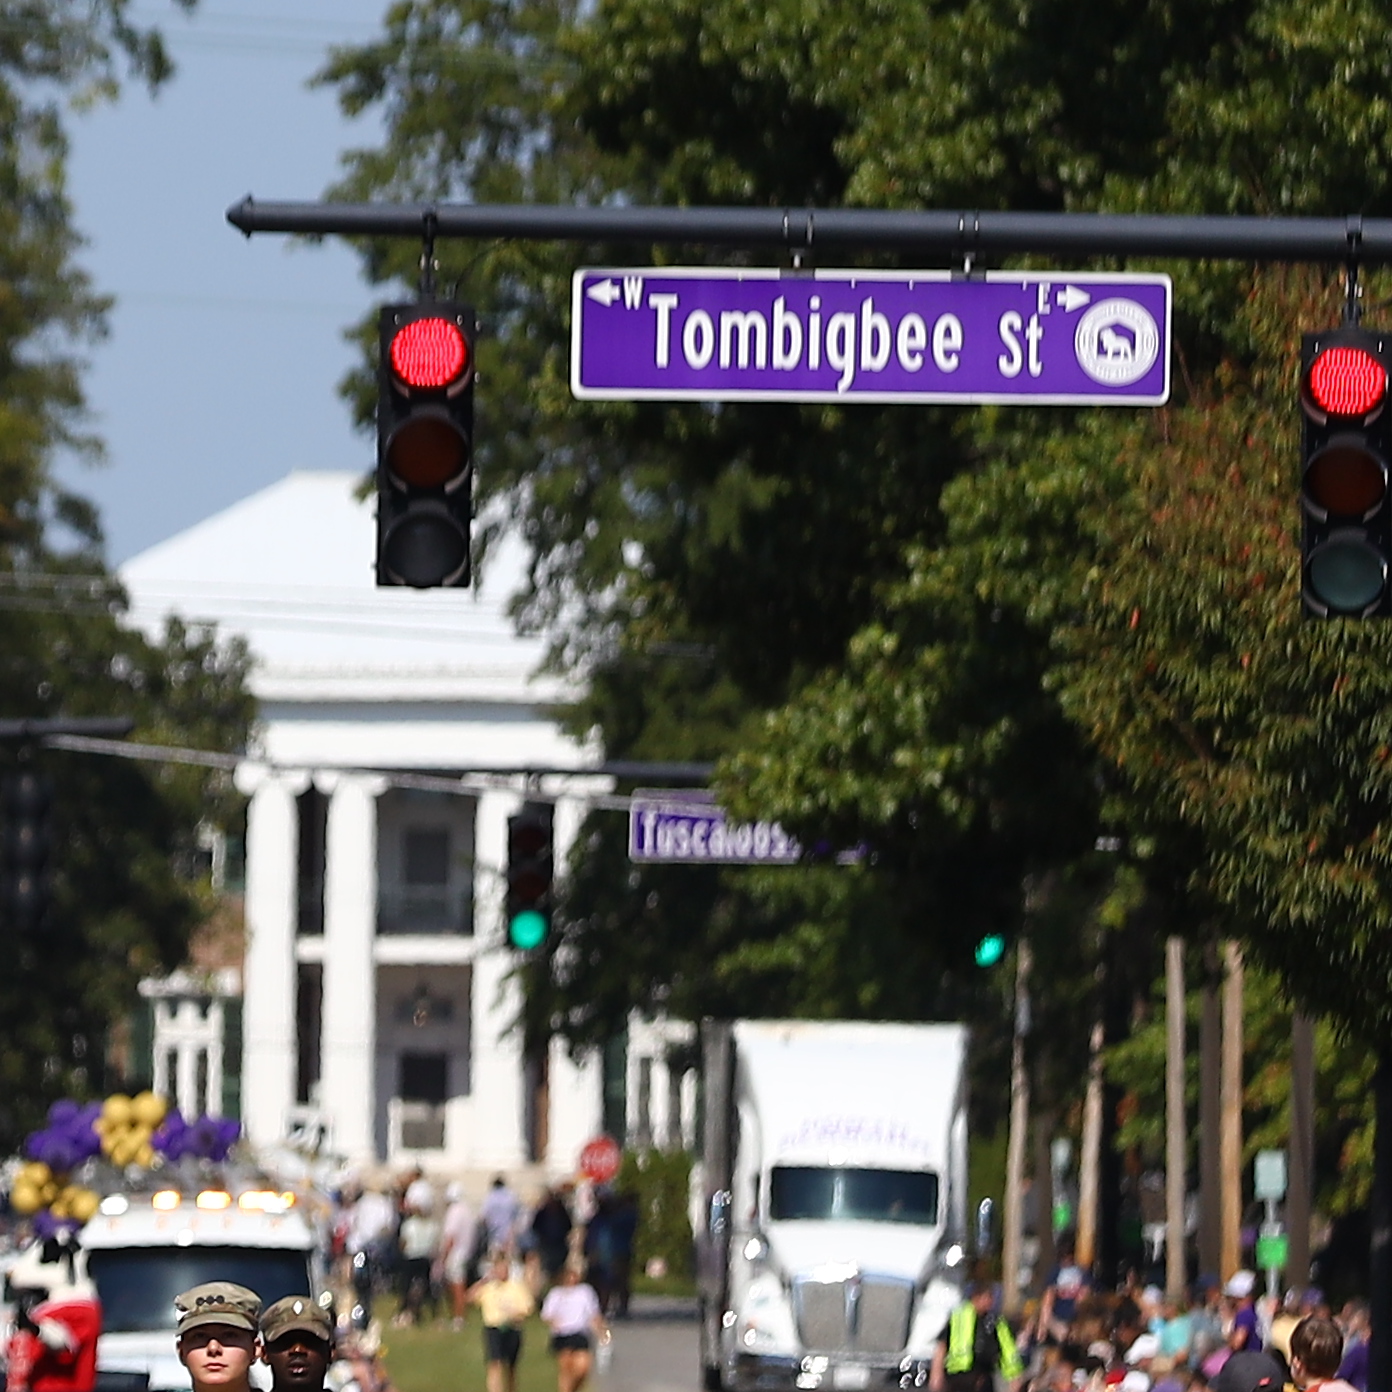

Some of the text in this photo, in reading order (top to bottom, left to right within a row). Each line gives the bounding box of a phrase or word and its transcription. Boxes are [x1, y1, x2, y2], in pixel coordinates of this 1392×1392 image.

[623, 276, 643, 311] W
[1037, 282, 1052, 315] E
[648, 293, 1044, 395] Tombigbee St
